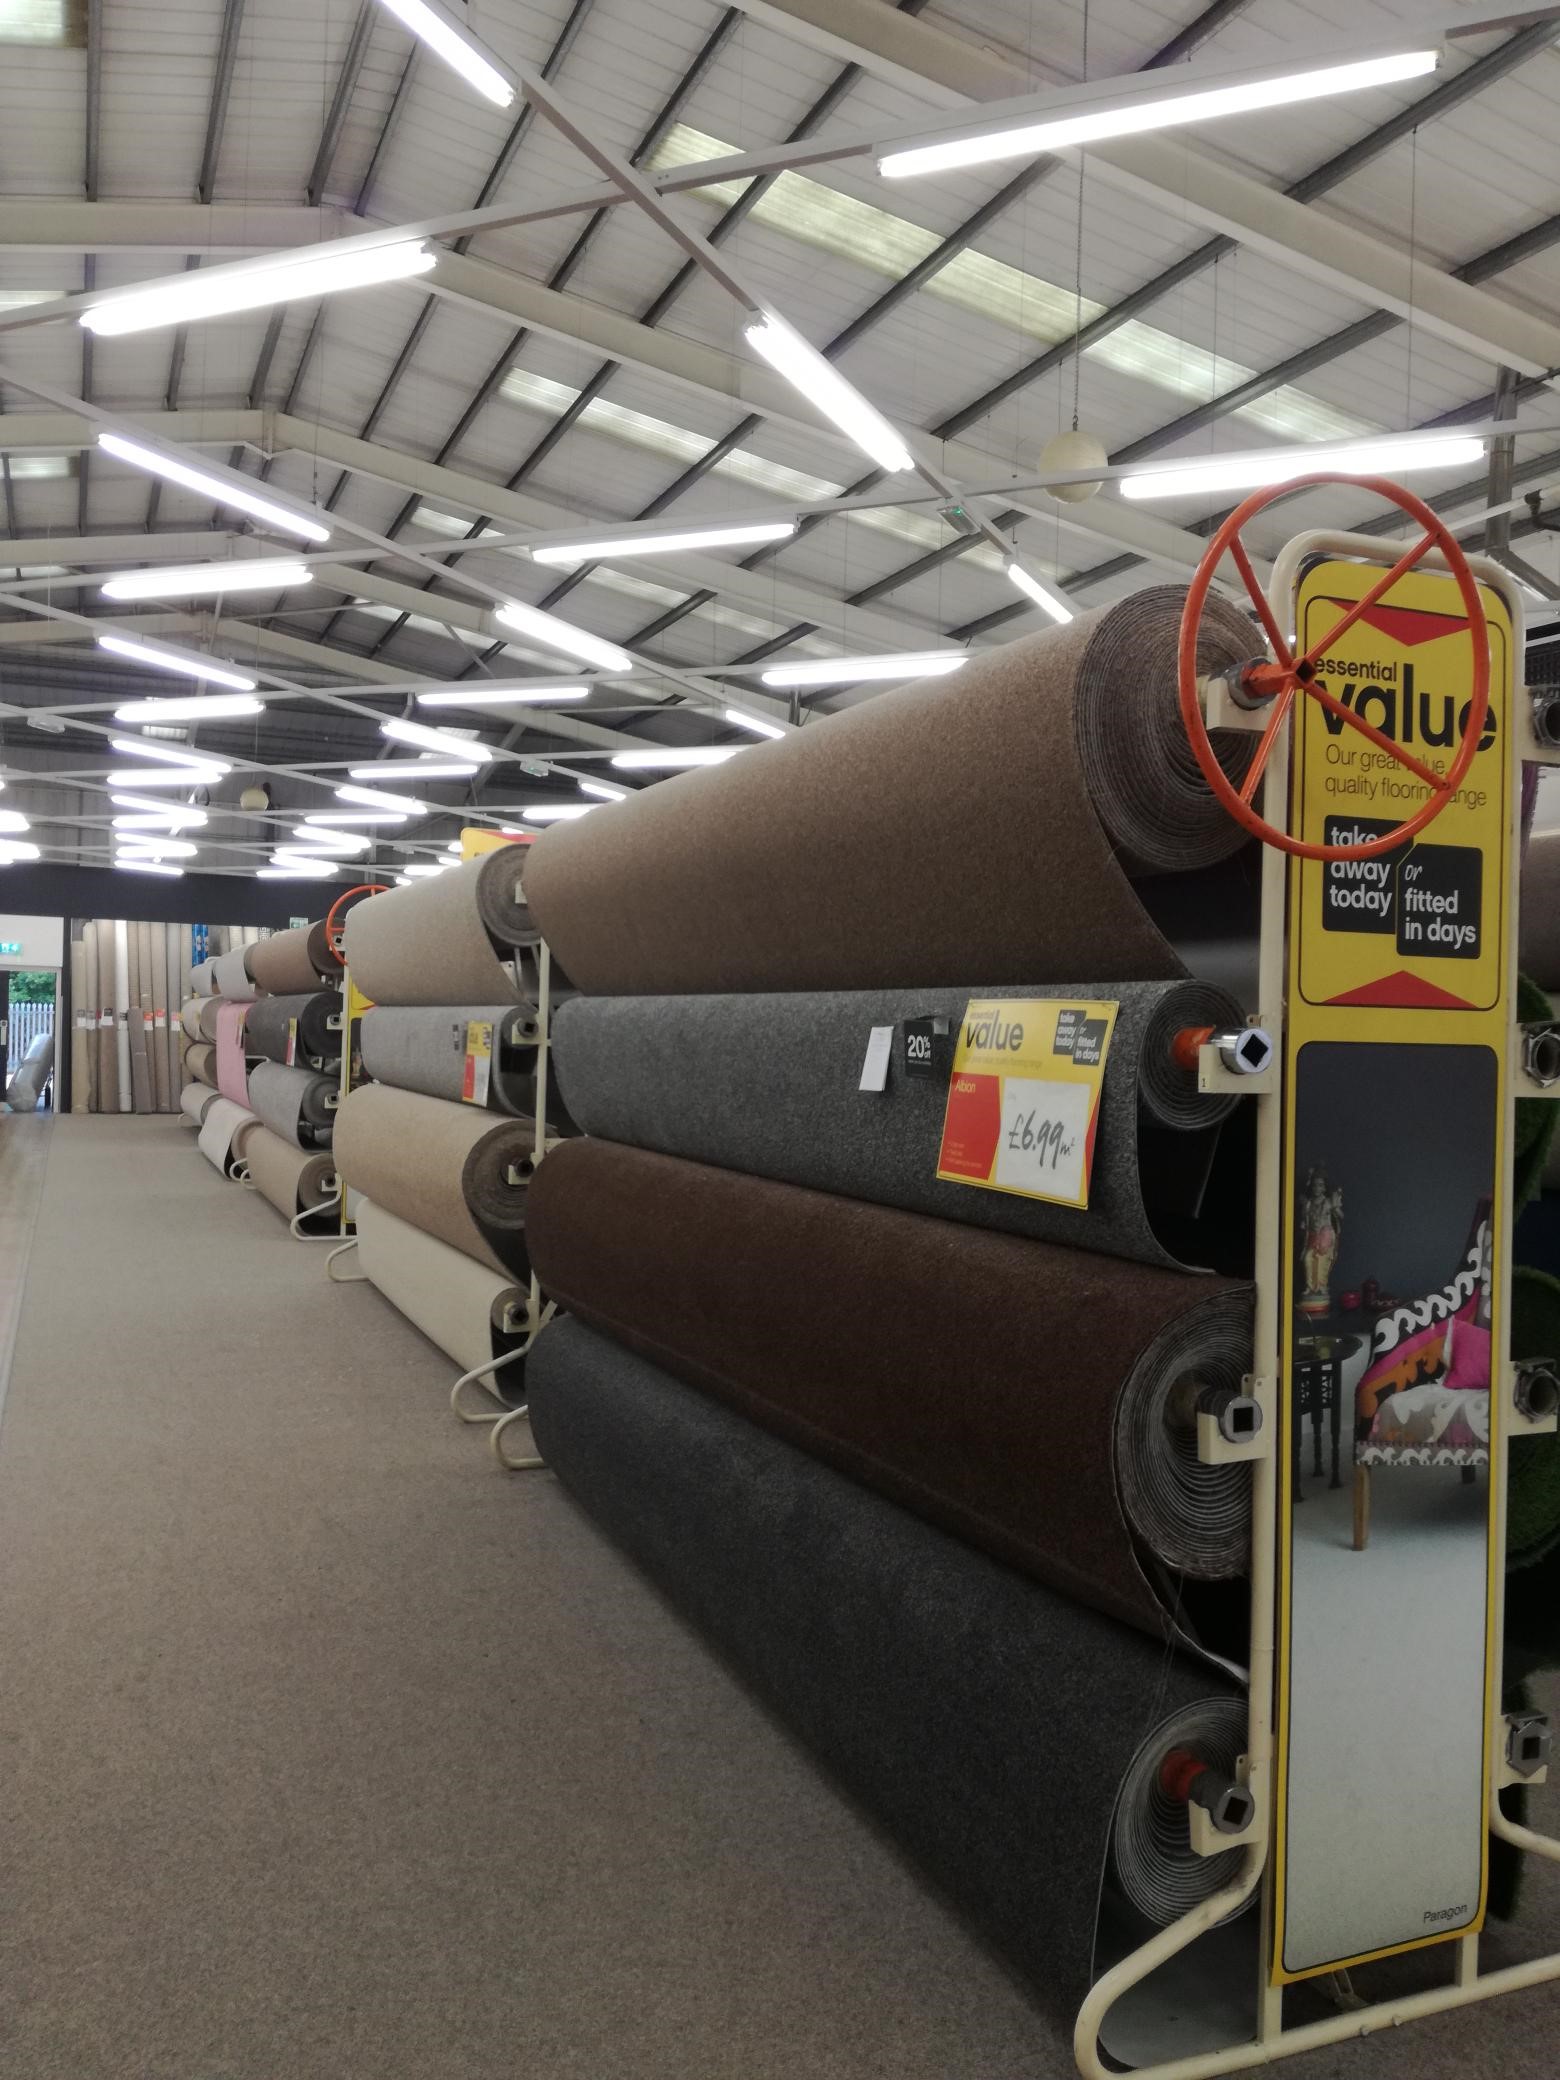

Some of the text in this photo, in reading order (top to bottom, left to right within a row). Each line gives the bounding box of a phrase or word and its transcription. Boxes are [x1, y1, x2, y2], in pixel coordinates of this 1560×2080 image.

[1314, 657, 1398, 682] essential
[1315, 663, 1498, 752] value
[1326, 743, 1357, 766] Our
[1325, 775, 1488, 810] quality floorin ange
[1330, 861, 1391, 888] away
[1404, 864, 1423, 881] or
[1329, 883, 1393, 917] today
[1404, 887, 1459, 914] fitted
[1404, 916, 1477, 950] in days
[966, 1009, 1024, 1051] value
[1008, 1109, 1065, 1170] £6.99
[1423, 1904, 1468, 1924] Paragon
